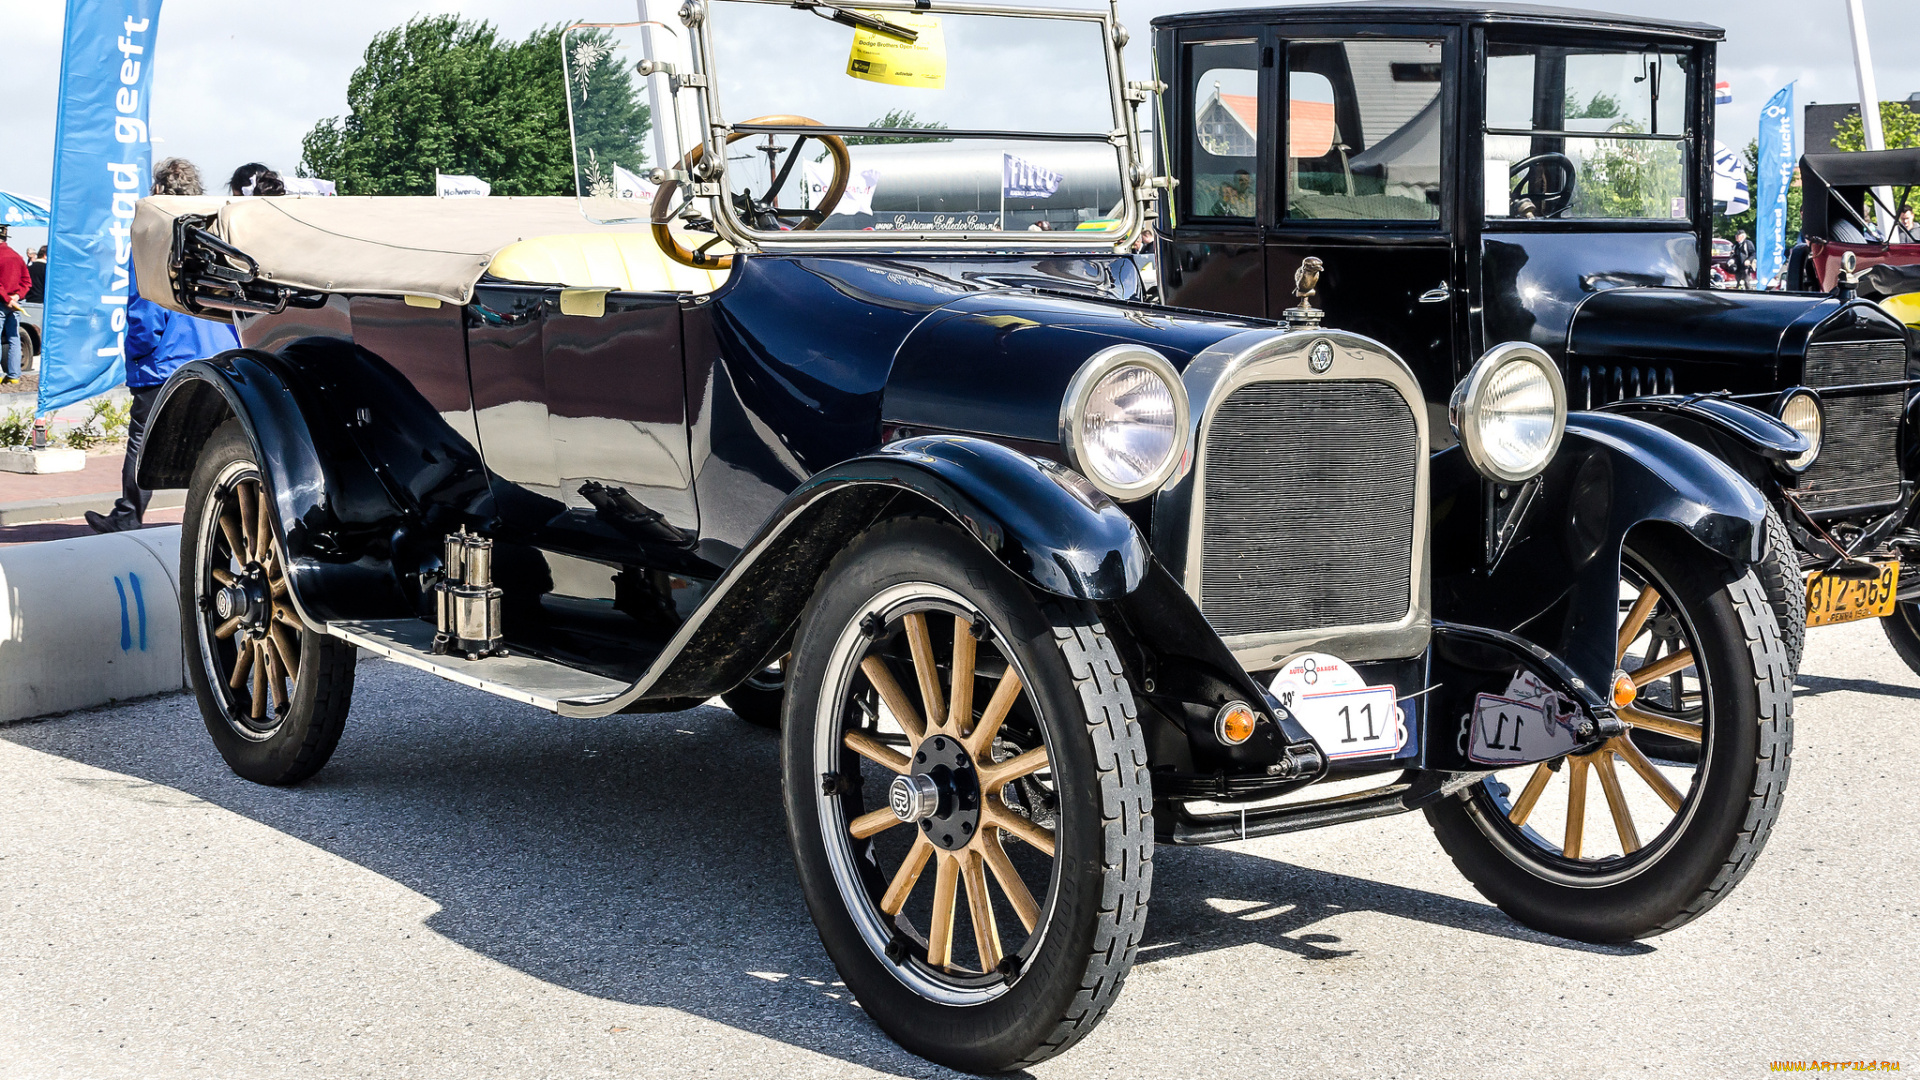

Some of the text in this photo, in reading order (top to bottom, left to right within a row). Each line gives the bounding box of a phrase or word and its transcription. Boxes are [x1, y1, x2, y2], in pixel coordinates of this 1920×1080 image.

[115, 15, 150, 143] geeft
[1779, 116, 1791, 157] lucht
[1289, 667, 1304, 675] AUTO
[1338, 703, 1380, 744] 11
